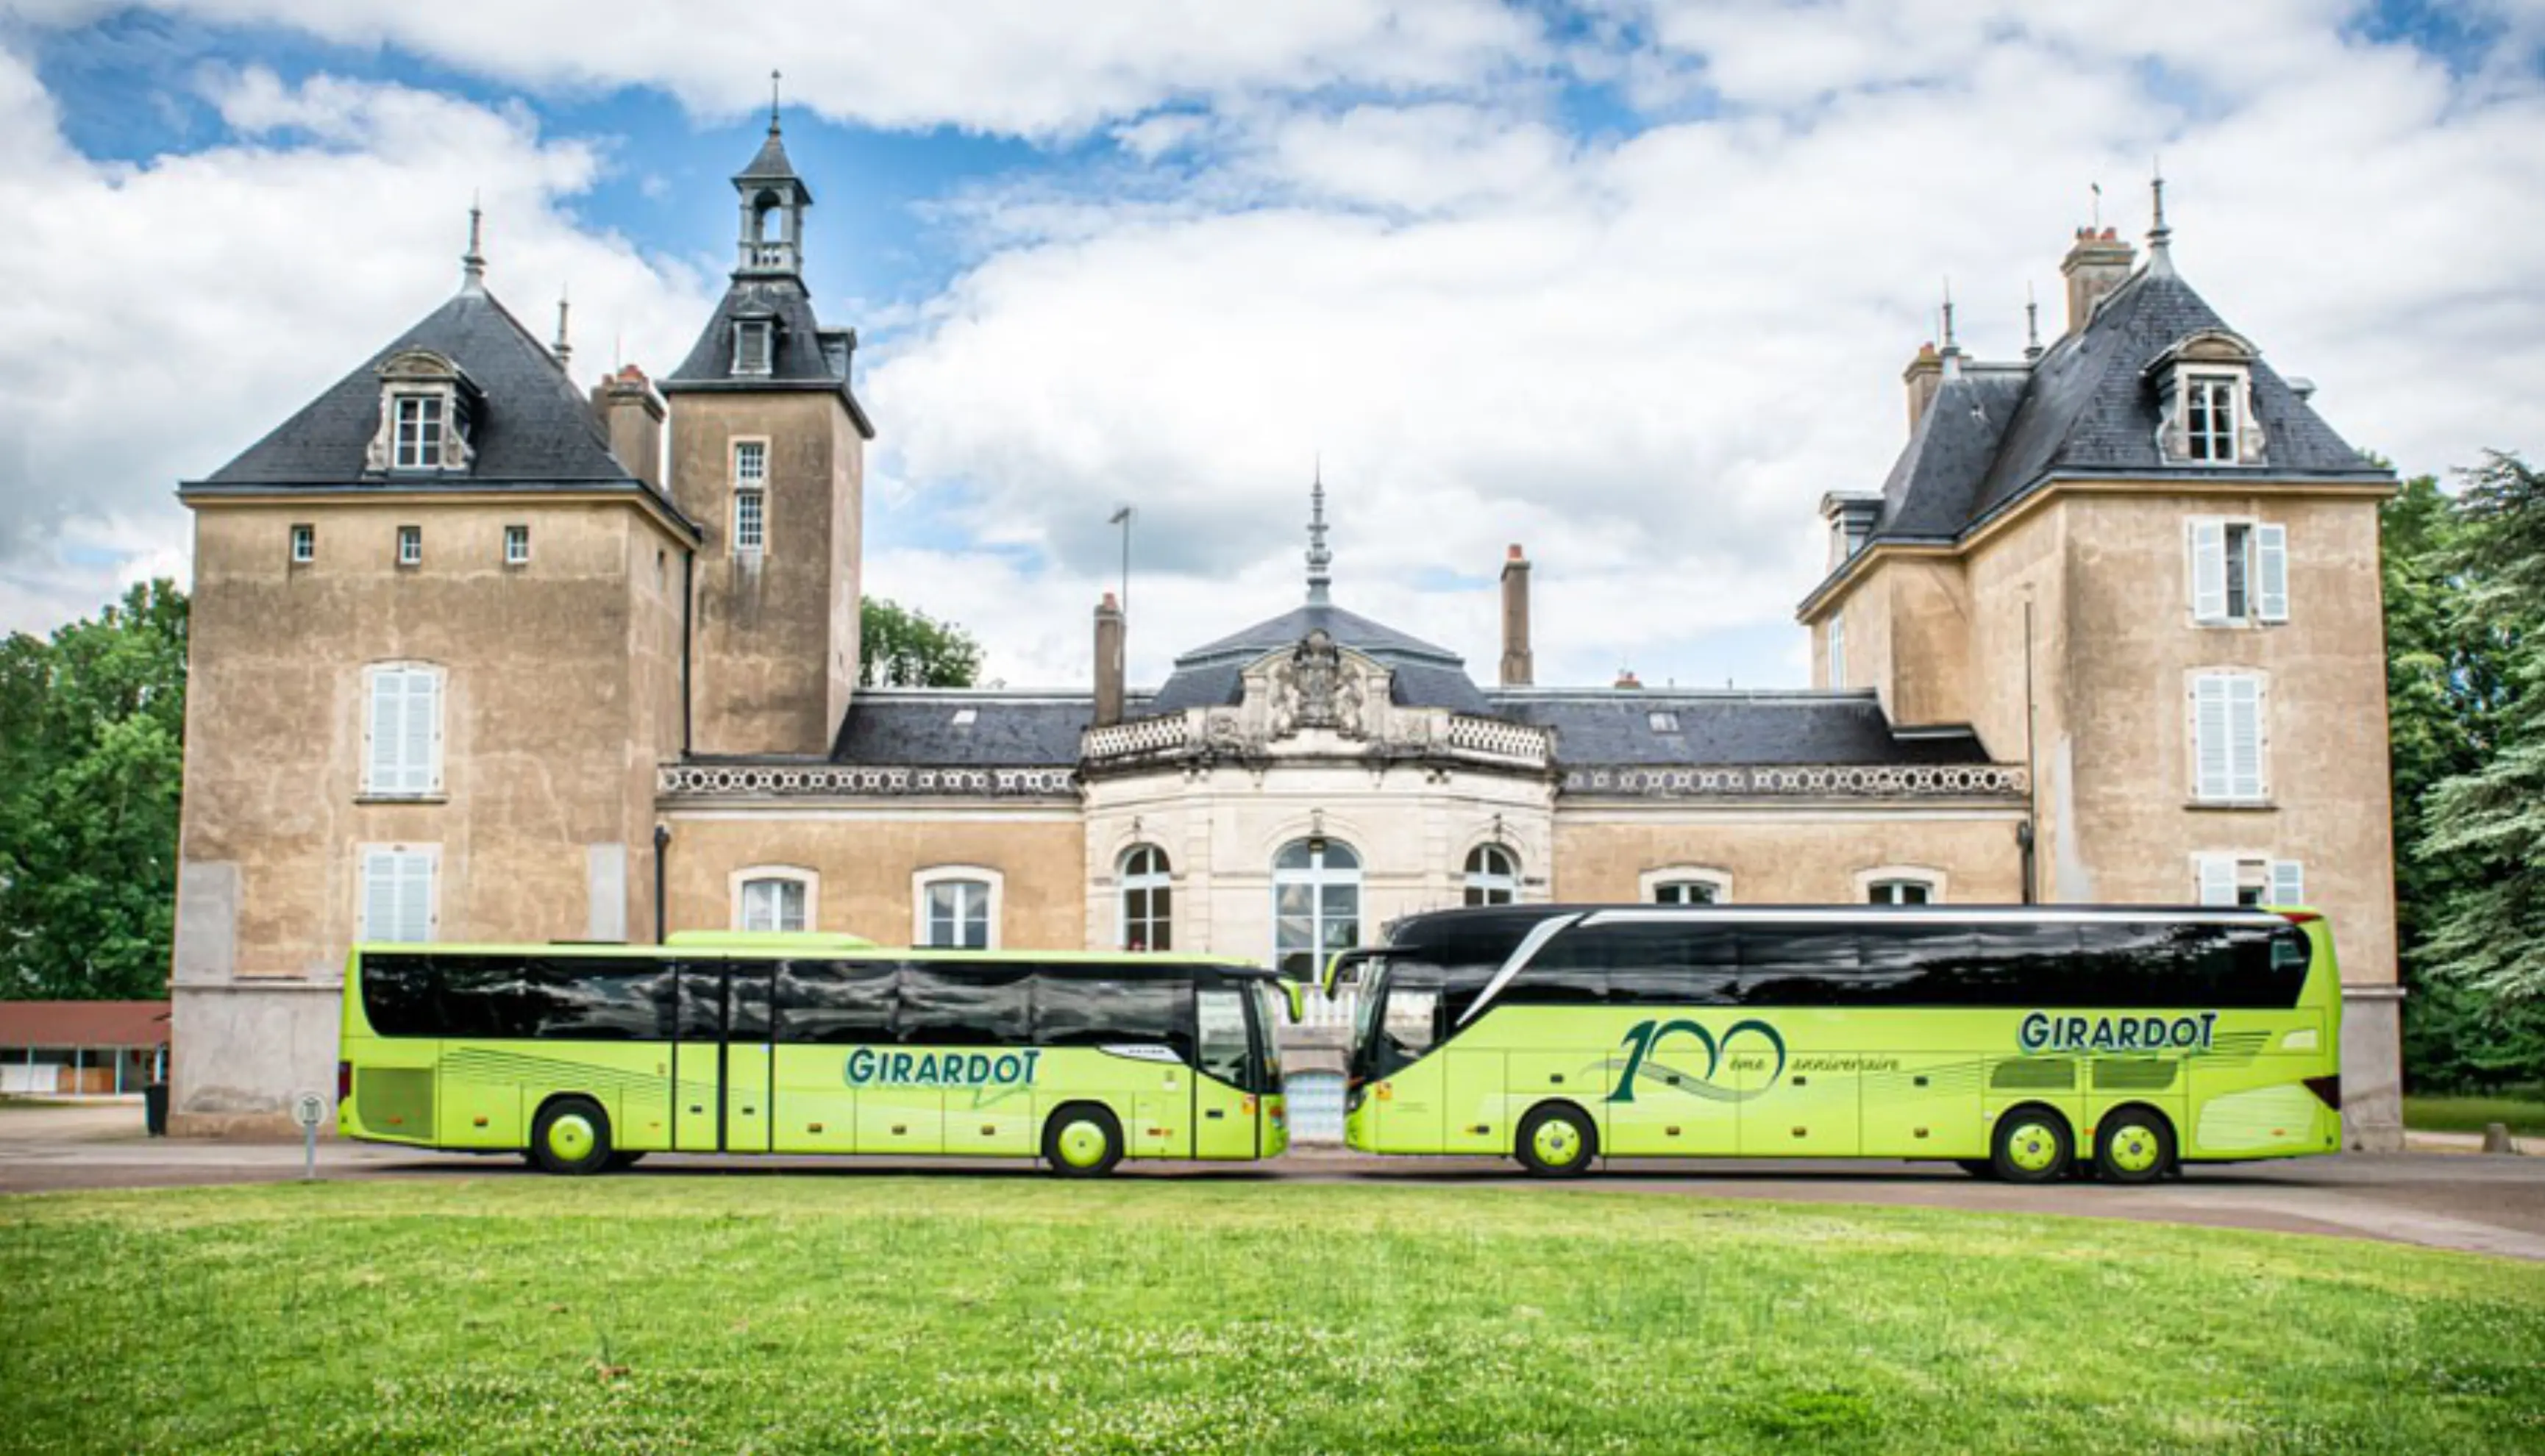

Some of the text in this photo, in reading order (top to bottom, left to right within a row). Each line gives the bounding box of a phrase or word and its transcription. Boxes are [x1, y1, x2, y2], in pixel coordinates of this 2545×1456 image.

[2021, 1011, 2218, 1049] GIRARDOT
[847, 1047, 1041, 1084] GIRARDOT
[1598, 1018, 1786, 1103] 100
